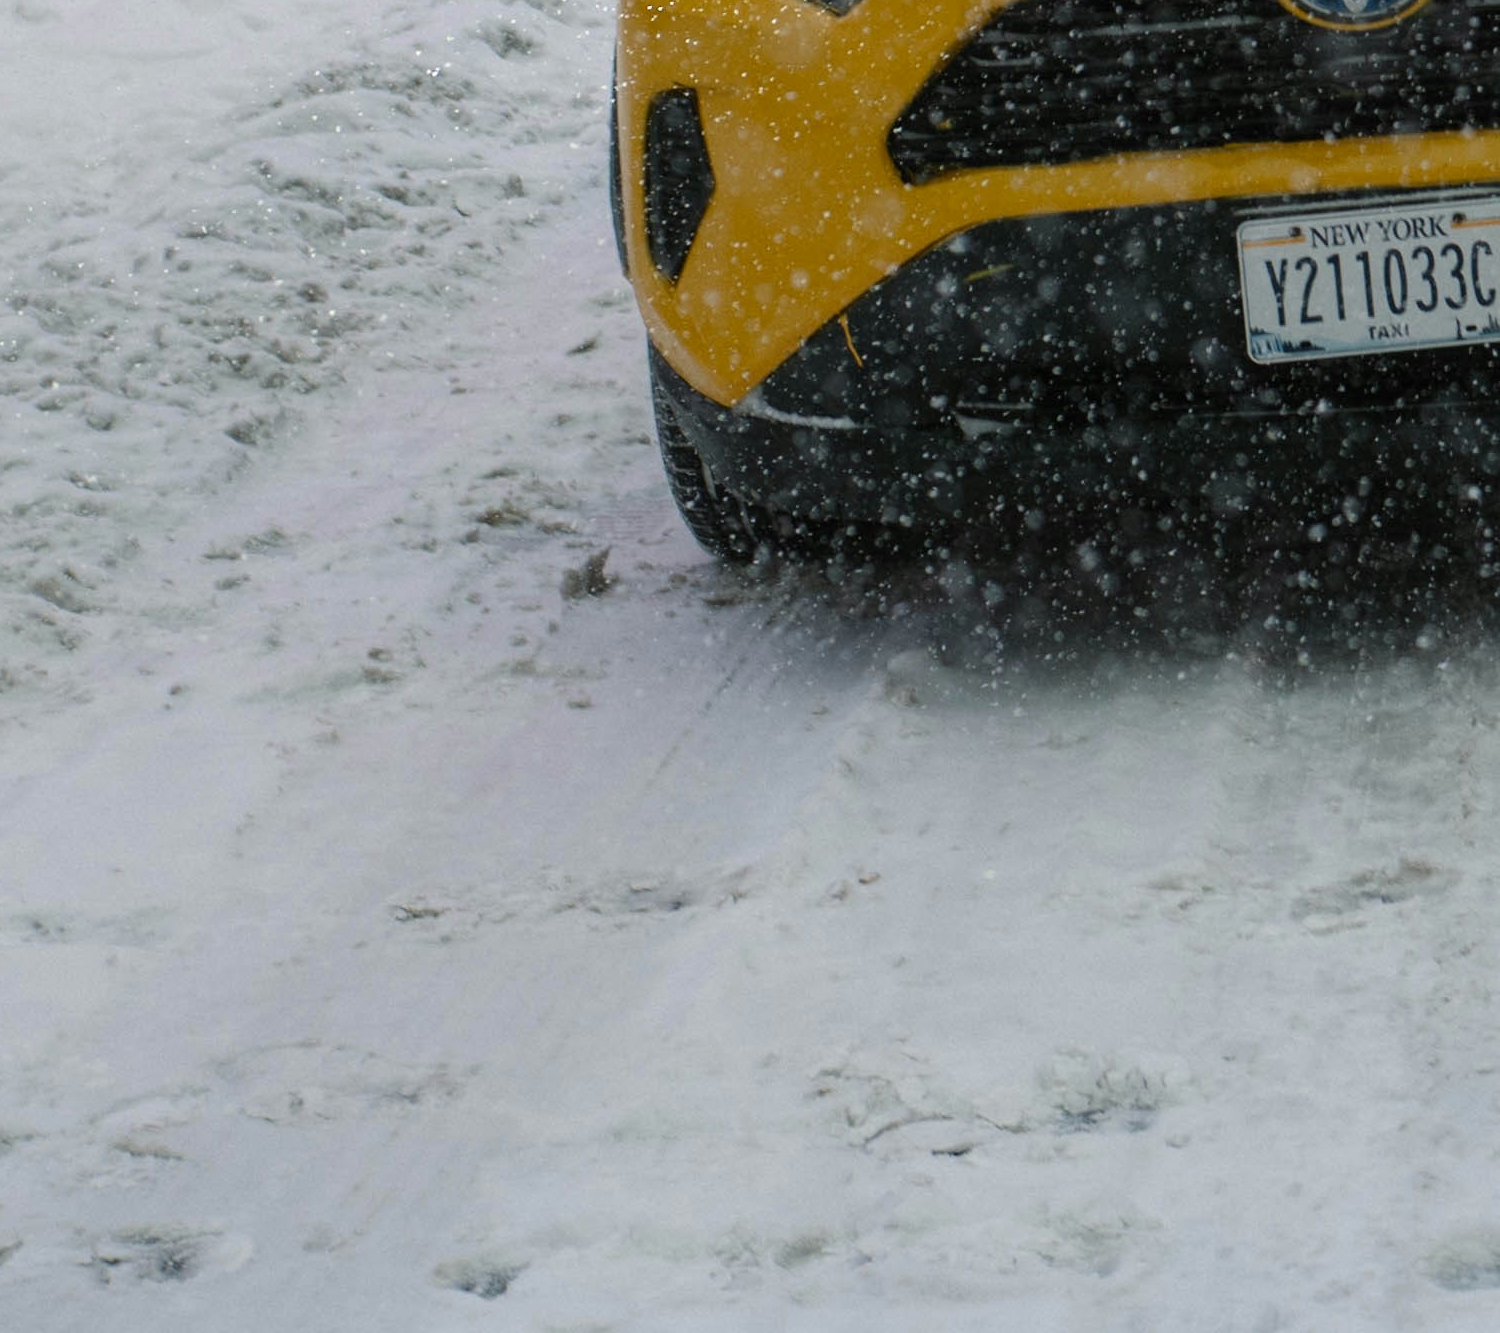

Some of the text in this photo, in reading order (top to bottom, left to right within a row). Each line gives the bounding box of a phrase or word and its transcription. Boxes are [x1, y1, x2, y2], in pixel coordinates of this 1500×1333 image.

[1309, 213, 1450, 250] NEW YORK
[1264, 239, 1497, 327] Y211033C
[1368, 322, 1412, 341] TAXI
